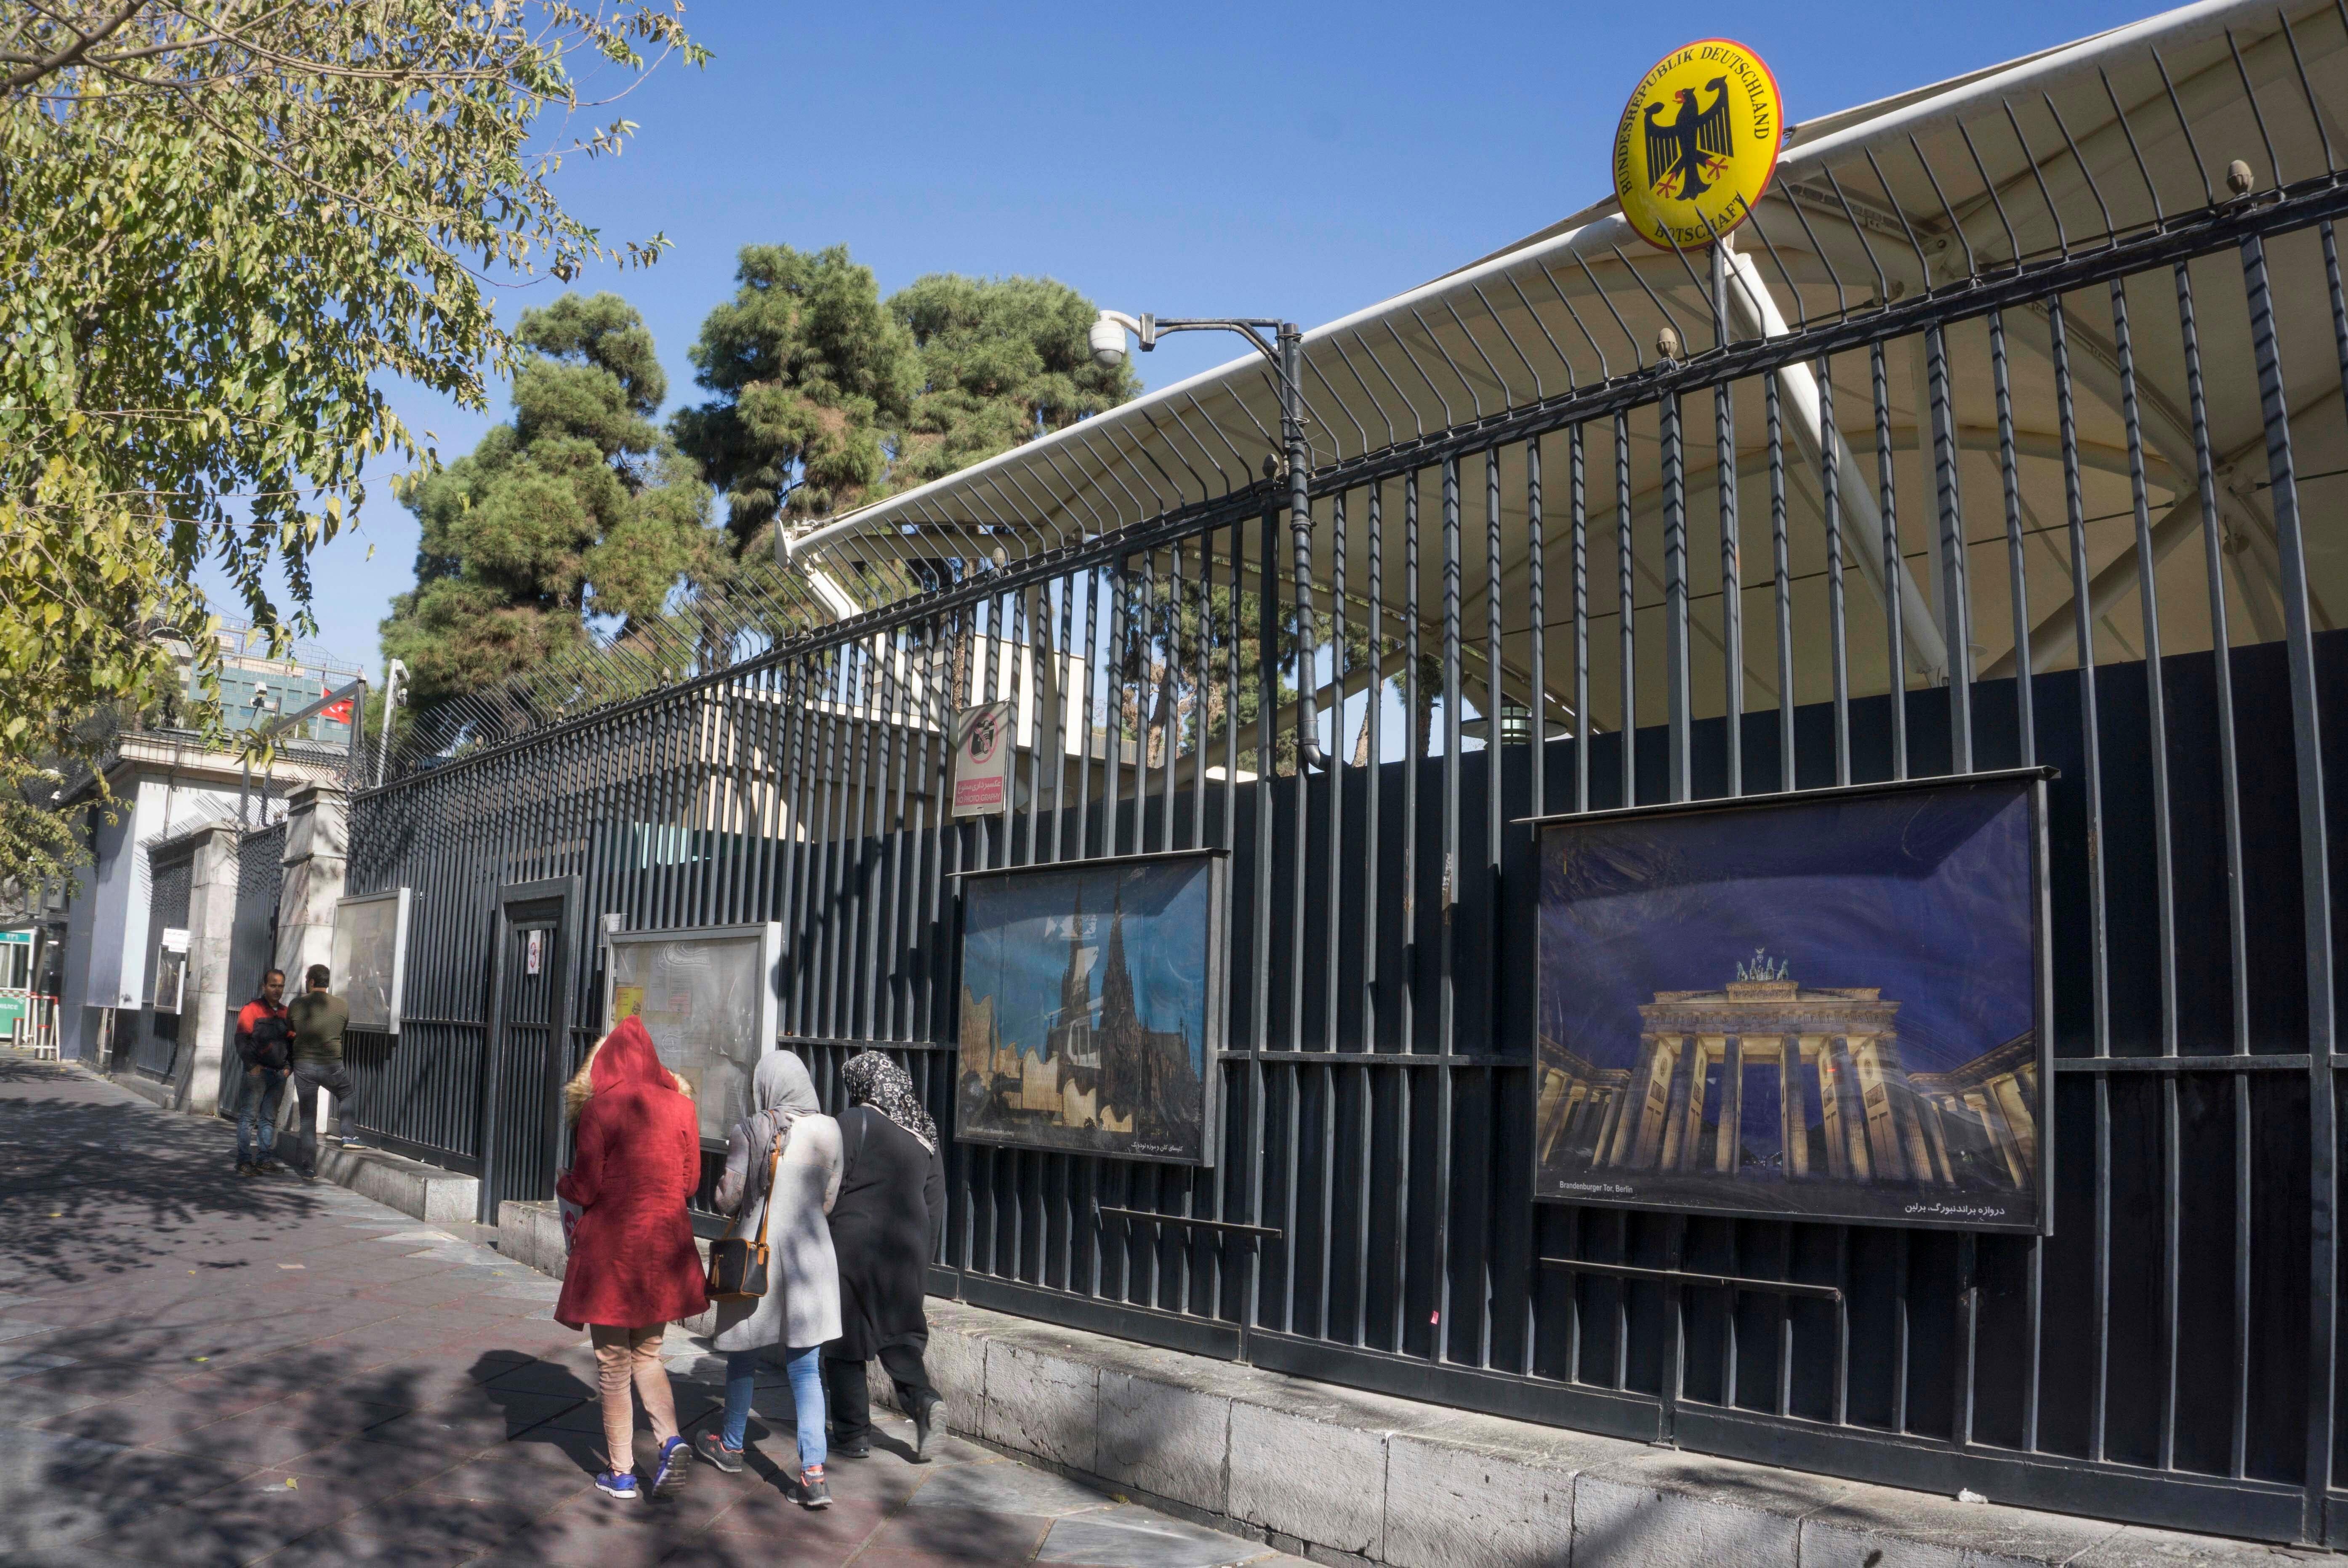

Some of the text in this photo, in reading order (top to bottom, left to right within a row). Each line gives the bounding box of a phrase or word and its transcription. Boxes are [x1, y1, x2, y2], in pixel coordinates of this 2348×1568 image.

[1618, 45, 1770, 197] BUNDESREPUBLIK DEUTSCHLAND
[980, 792, 1001, 801] GRAPHY
[1559, 1181, 1633, 1193] Brandenburger Tor, Berlin
[1905, 1203, 1926, 1213] برلین
[1978, 1206, 2005, 1217] دروازه
